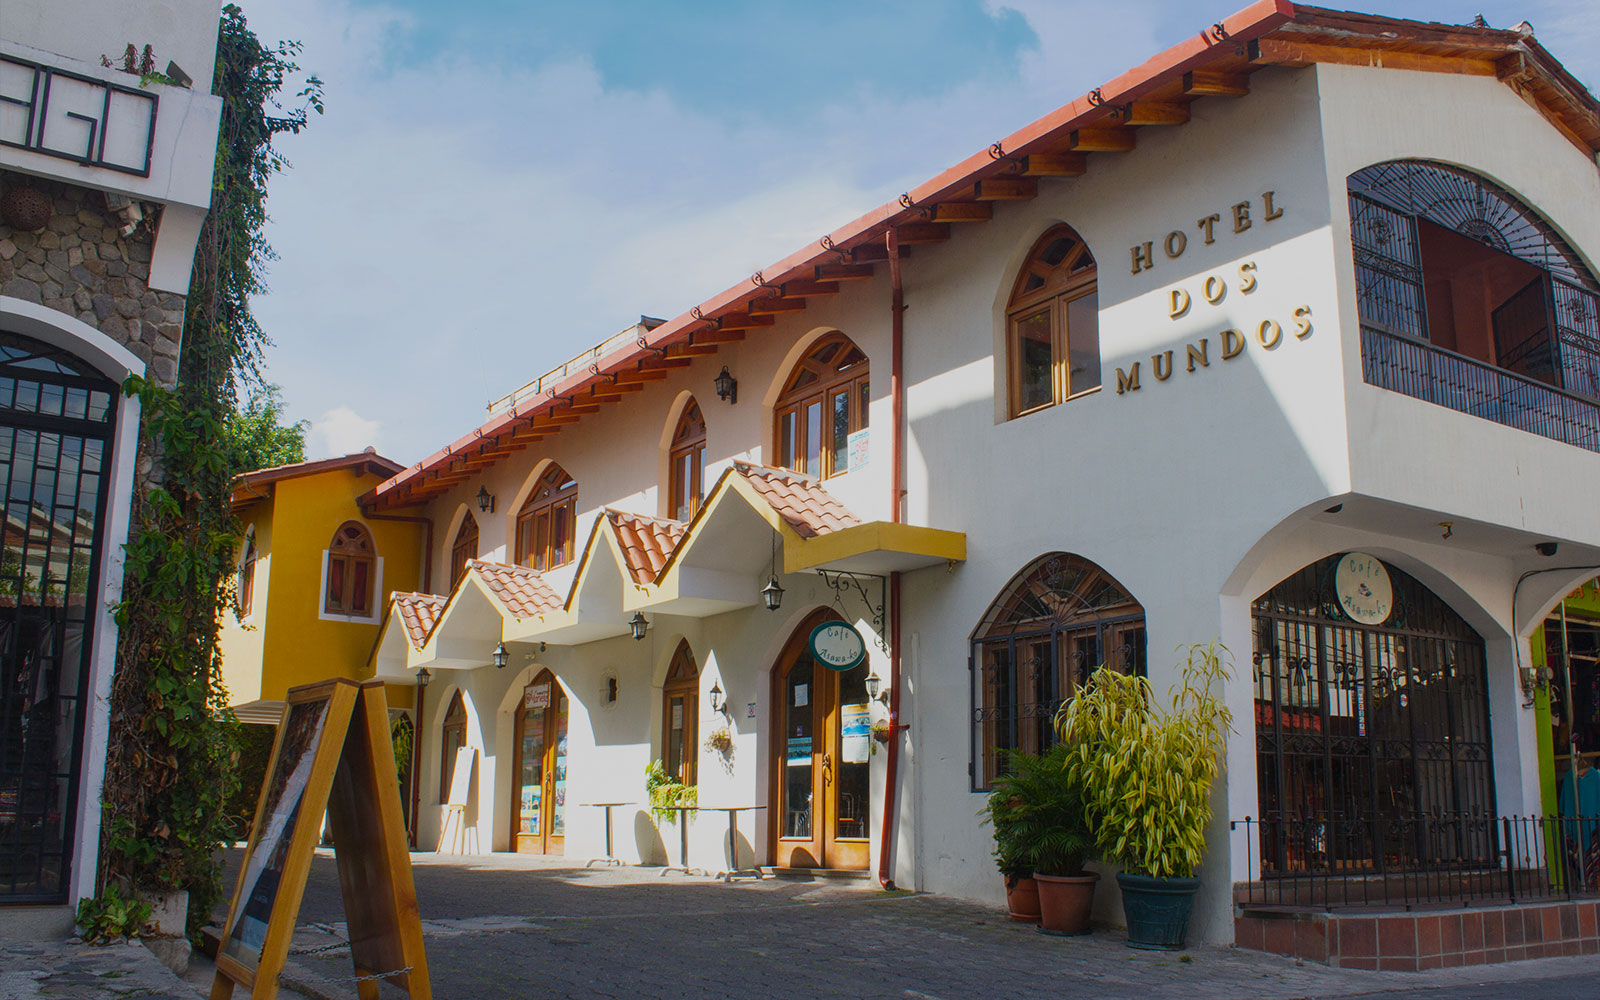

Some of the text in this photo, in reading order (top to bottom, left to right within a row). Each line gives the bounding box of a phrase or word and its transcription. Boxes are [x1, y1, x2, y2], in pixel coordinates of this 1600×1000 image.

[1130, 191, 1284, 275] HOTEL
[1167, 261, 1257, 319] DOS
[1115, 305, 1312, 395] MUNDOS
